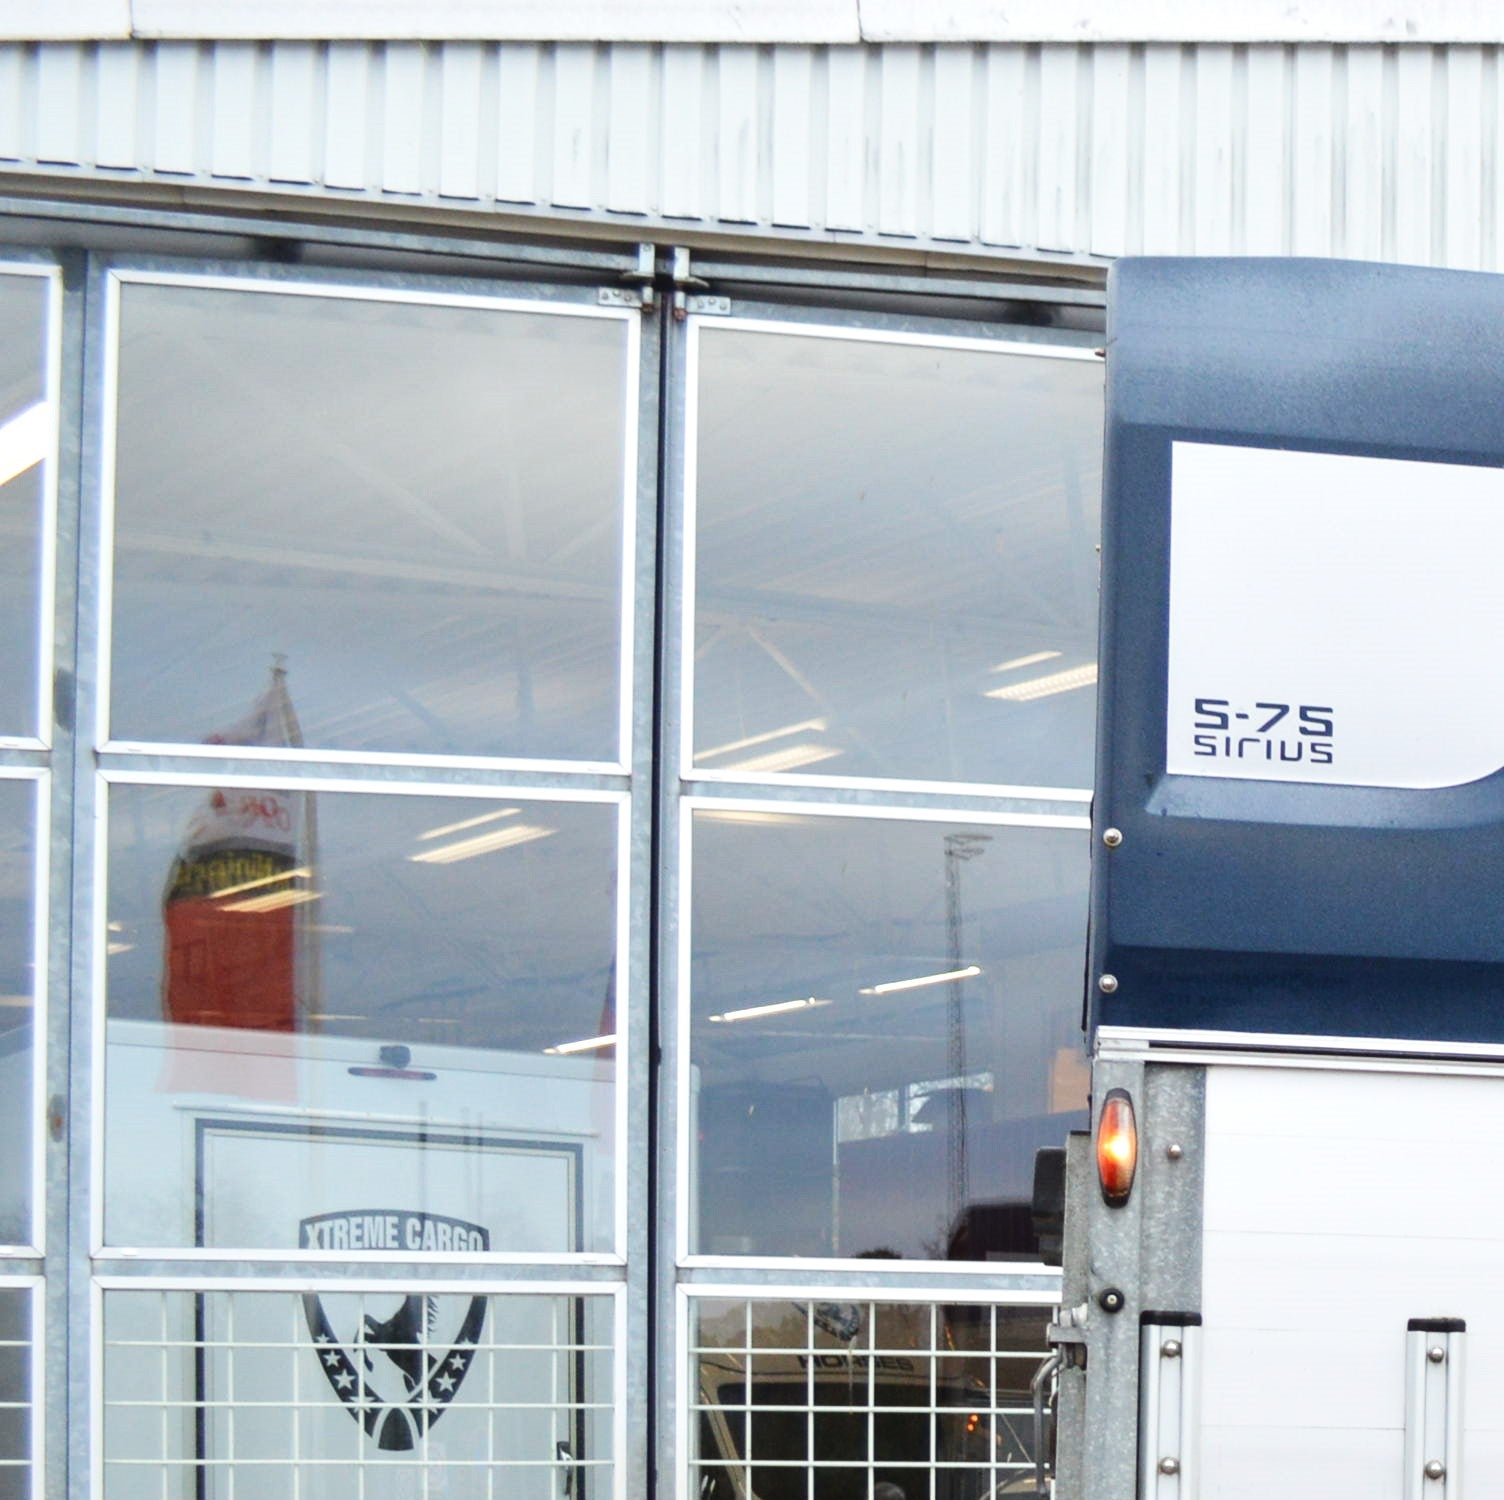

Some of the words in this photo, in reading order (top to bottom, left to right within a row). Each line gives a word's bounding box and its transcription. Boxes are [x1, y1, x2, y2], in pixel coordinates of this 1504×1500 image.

[1194, 698, 1333, 737] S-75
[305, 1216, 399, 1250] XTREME
[405, 1218, 484, 1251] CARGO
